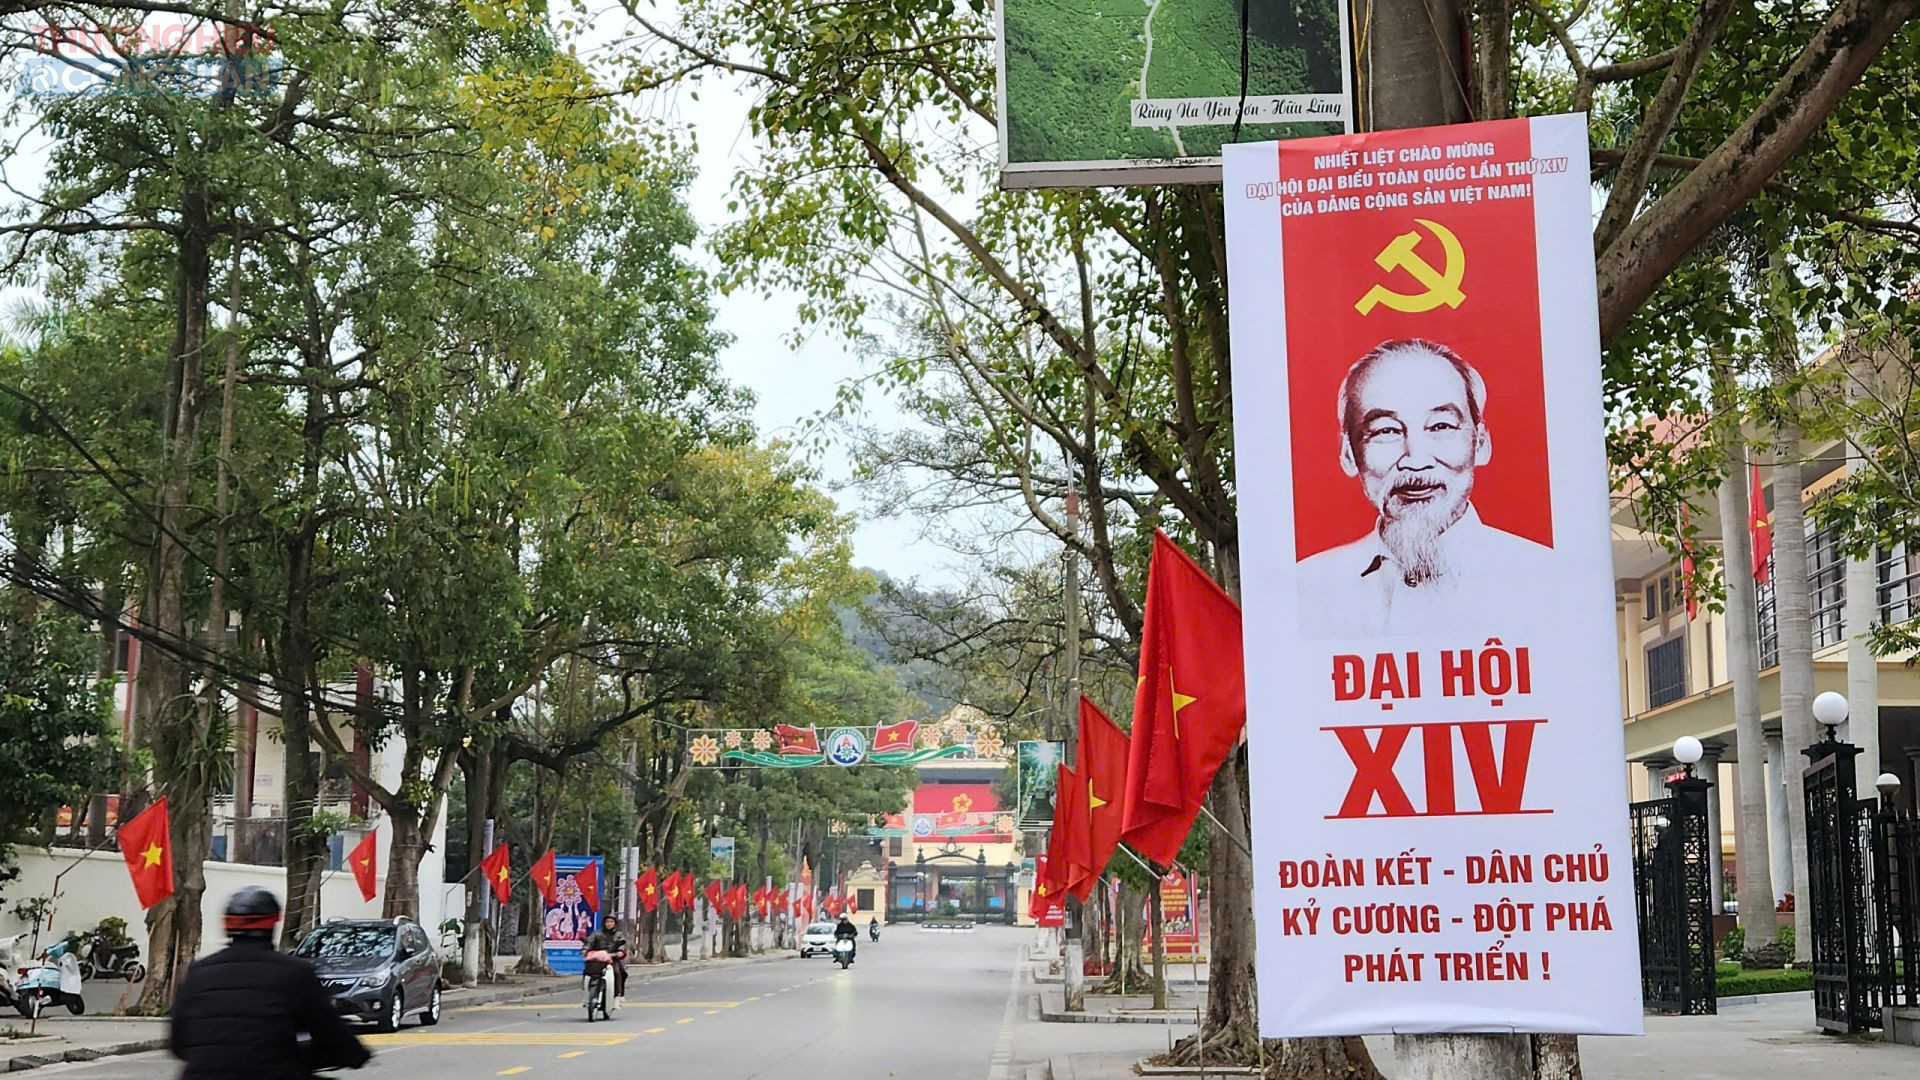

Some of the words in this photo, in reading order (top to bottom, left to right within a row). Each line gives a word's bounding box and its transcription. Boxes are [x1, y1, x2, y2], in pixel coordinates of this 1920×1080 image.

[1135, 103, 1172, 120] Rừng
[1203, 101, 1231, 120] Yên
[1307, 98, 1341, 116] Lũng
[1314, 150, 1359, 170] NHIỆT
[1363, 147, 1395, 166] LIỆT
[1399, 144, 1442, 162] CHÀO
[1446, 141, 1495, 159] MỪNG
[1246, 182, 1273, 200] ĐẠI
[1276, 177, 1303, 197] HỘI
[1306, 176, 1333, 194] ĐẠI
[1337, 168, 1373, 190] BIỂU
[1377, 167, 1419, 186] TOÀN
[1423, 162, 1466, 184] QUỐC
[1470, 159, 1502, 180] LẦN
[1505, 156, 1538, 176] THỨ
[1540, 156, 1568, 174] XIV
[1282, 198, 1314, 217] CỦA
[1317, 194, 1360, 214] ĐẢNG
[1364, 191, 1408, 211] CỘNG
[1412, 186, 1445, 205] SẢN
[1450, 185, 1483, 204] VIỆT
[1487, 183, 1531, 200] NAM!
[1331, 650, 1421, 711] ĐẠI
[1440, 637, 1532, 707] HỘI
[1319, 718, 1555, 820] XIV
[1278, 852, 1365, 889] ĐOÀN
[1375, 847, 1432, 886] KẾT
[1465, 848, 1533, 884] DÂN
[1543, 842, 1609, 883] CHỦ
[1282, 897, 1321, 936] KỶ
[1332, 902, 1440, 934] CƯƠNG
[1473, 897, 1534, 939] ĐỘT
[1545, 895, 1613, 932] PHÁ
[1343, 947, 1425, 983] PHÁT
[1435, 939, 1529, 982] TRIỂN
